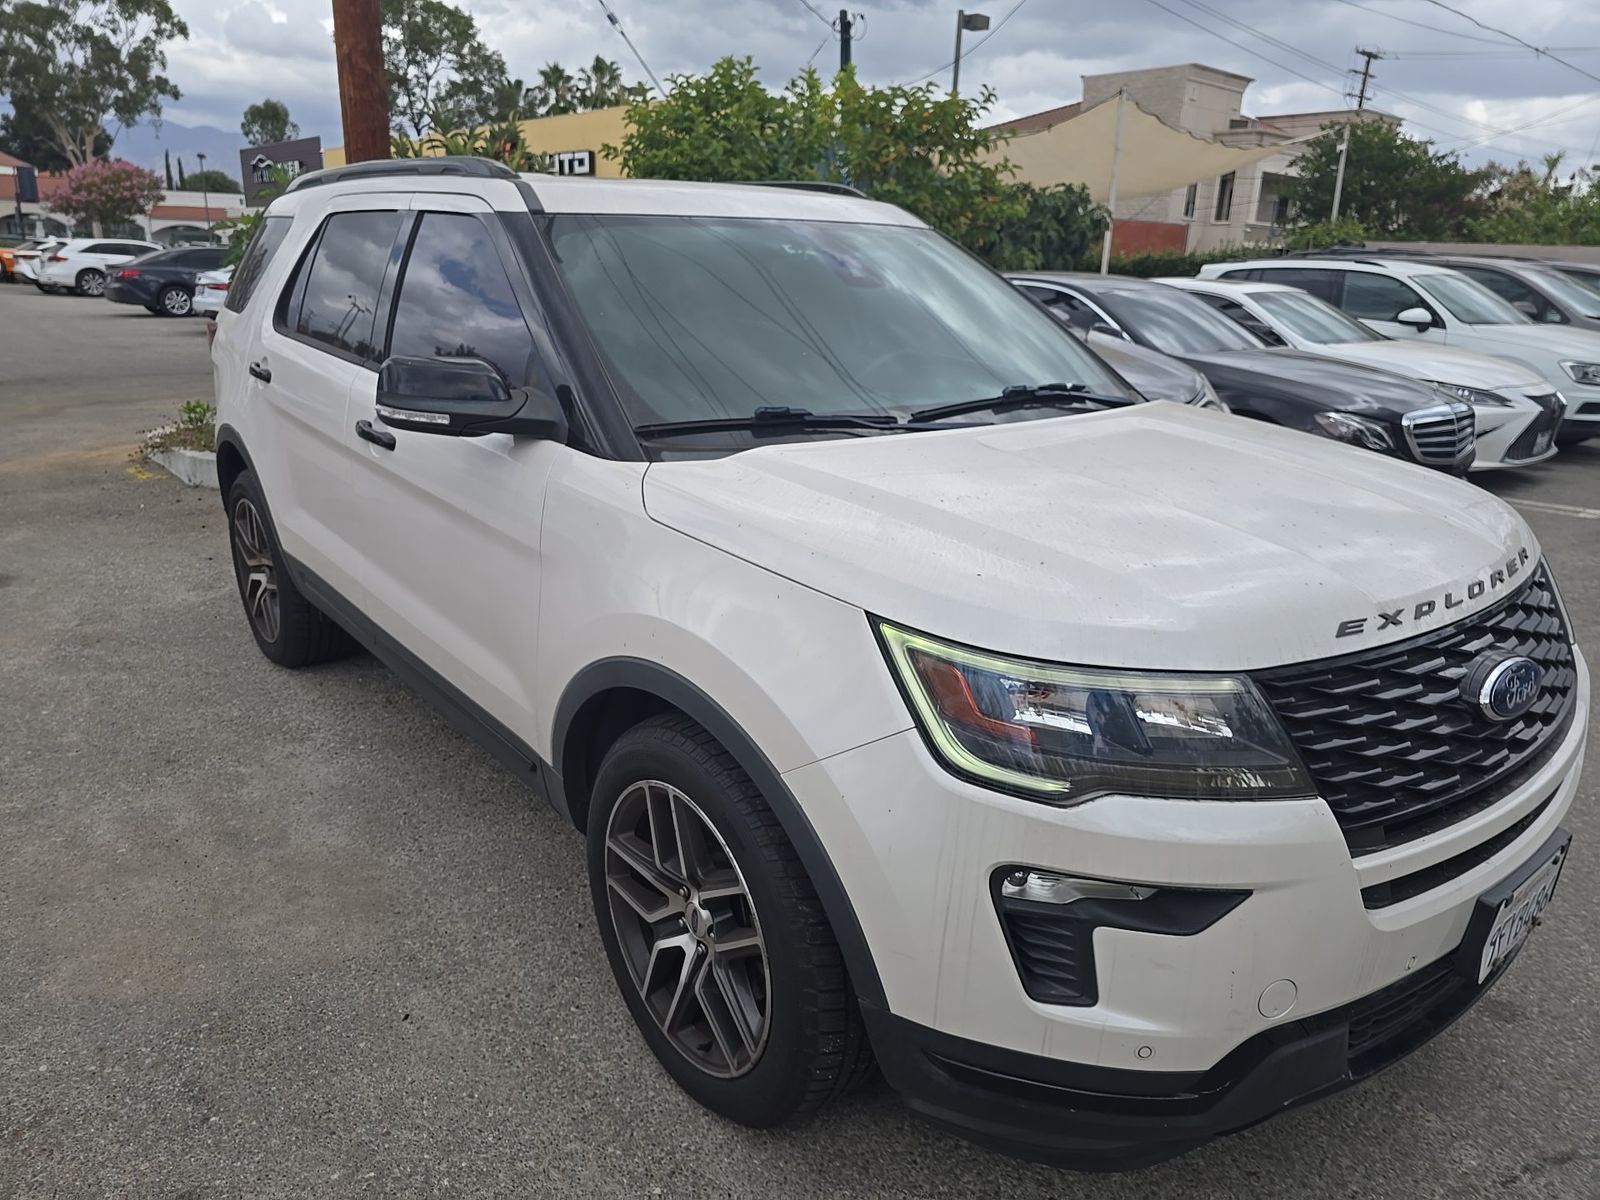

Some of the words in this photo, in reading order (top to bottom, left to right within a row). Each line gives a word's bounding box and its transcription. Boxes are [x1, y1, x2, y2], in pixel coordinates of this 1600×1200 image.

[541, 151, 590, 176] UTO
[1335, 547, 1529, 638] EXPLORER
[1505, 668, 1537, 709] Ford
